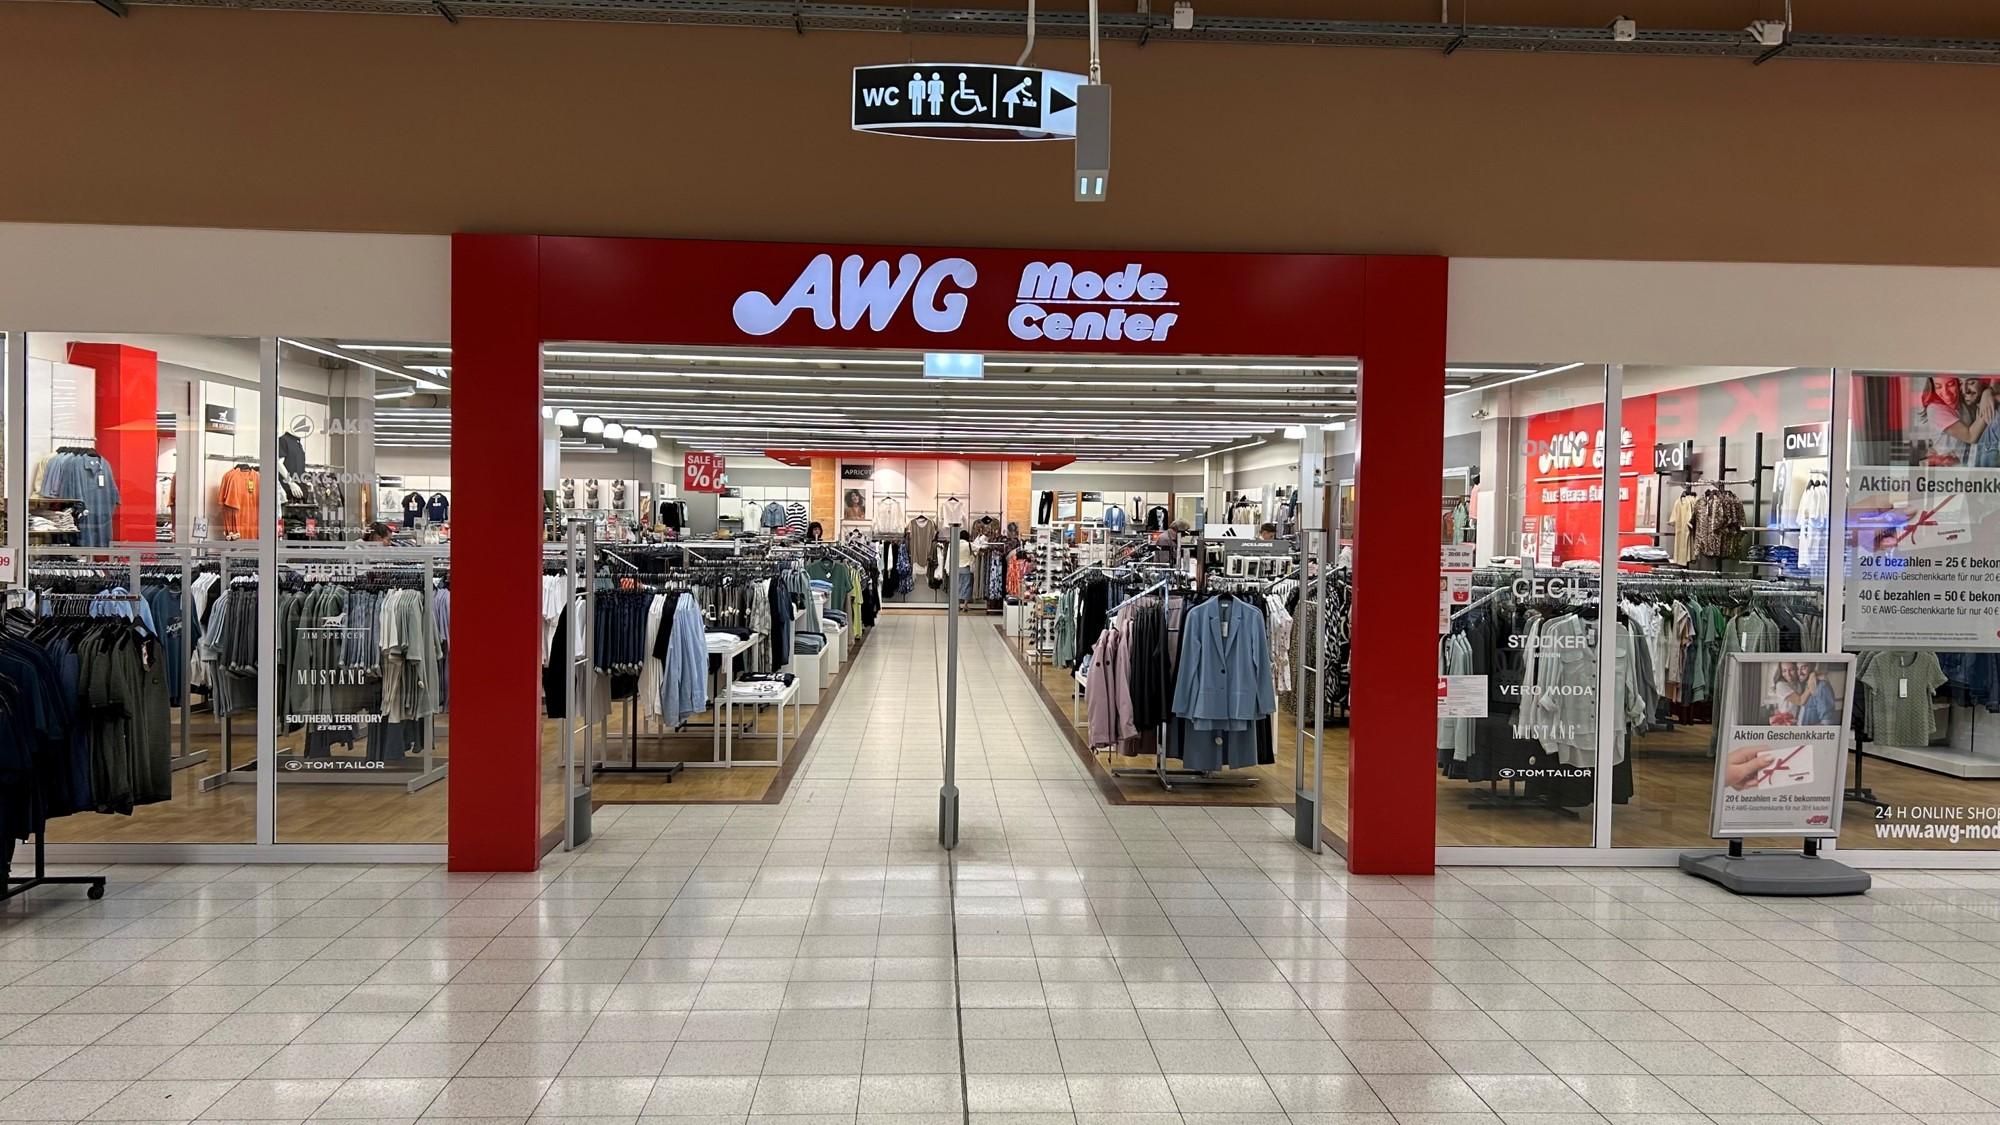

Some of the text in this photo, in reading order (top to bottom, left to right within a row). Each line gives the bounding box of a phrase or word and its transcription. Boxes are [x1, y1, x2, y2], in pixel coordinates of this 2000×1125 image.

[862, 86, 900, 107] WC
[1017, 261, 1169, 300] Mode
[732, 253, 978, 335] AWG
[1007, 303, 1178, 341] Center
[1786, 431, 1823, 450] ONLY
[687, 455, 711, 465] SALE
[713, 460, 723, 468] LE
[1859, 475, 2000, 493] Aktion Geschenkk
[1860, 556, 1873, 567] 20
[1875, 556, 1882, 567] €
[1885, 556, 1931, 568] bezahlen
[1946, 557, 1958, 568] 25
[1961, 557, 1968, 568] €
[1862, 571, 1873, 580] 25
[1880, 572, 1955, 582] AWG-Geschenkkarte
[1957, 572, 1968, 582] für
[1970, 574, 1983, 582] nur
[1984, 572, 1995, 582] 20
[1512, 578, 1588, 598] CECIL
[1858, 590, 1872, 601] 40
[1874, 590, 1881, 601] €
[1884, 590, 1930, 601] bezahlen
[1944, 591, 1958, 601] 50
[1960, 591, 1966, 601] €
[1861, 605, 1871, 614] 50
[1879, 605, 1954, 615] AWG-Geschenkkarte
[1957, 606, 1968, 615] für
[1983, 607, 1994, 615] 40
[302, 630, 365, 640] JIM SPENCER
[1508, 634, 1586, 649] STOOKER
[297, 669, 365, 685] MUSTANG
[1500, 685, 1593, 696] VERO MODA
[285, 714, 383, 724] SOUTHERN TERRITORY
[1734, 730, 1836, 740] Aktion Geschenkkarte
[304, 761, 385, 769] TOM TAILOR
[1517, 769, 1592, 778] TOM TAILOR
[1875, 806, 1892, 819] 24
[1897, 806, 1907, 819] H
[1911, 806, 1964, 819] ONLINE
